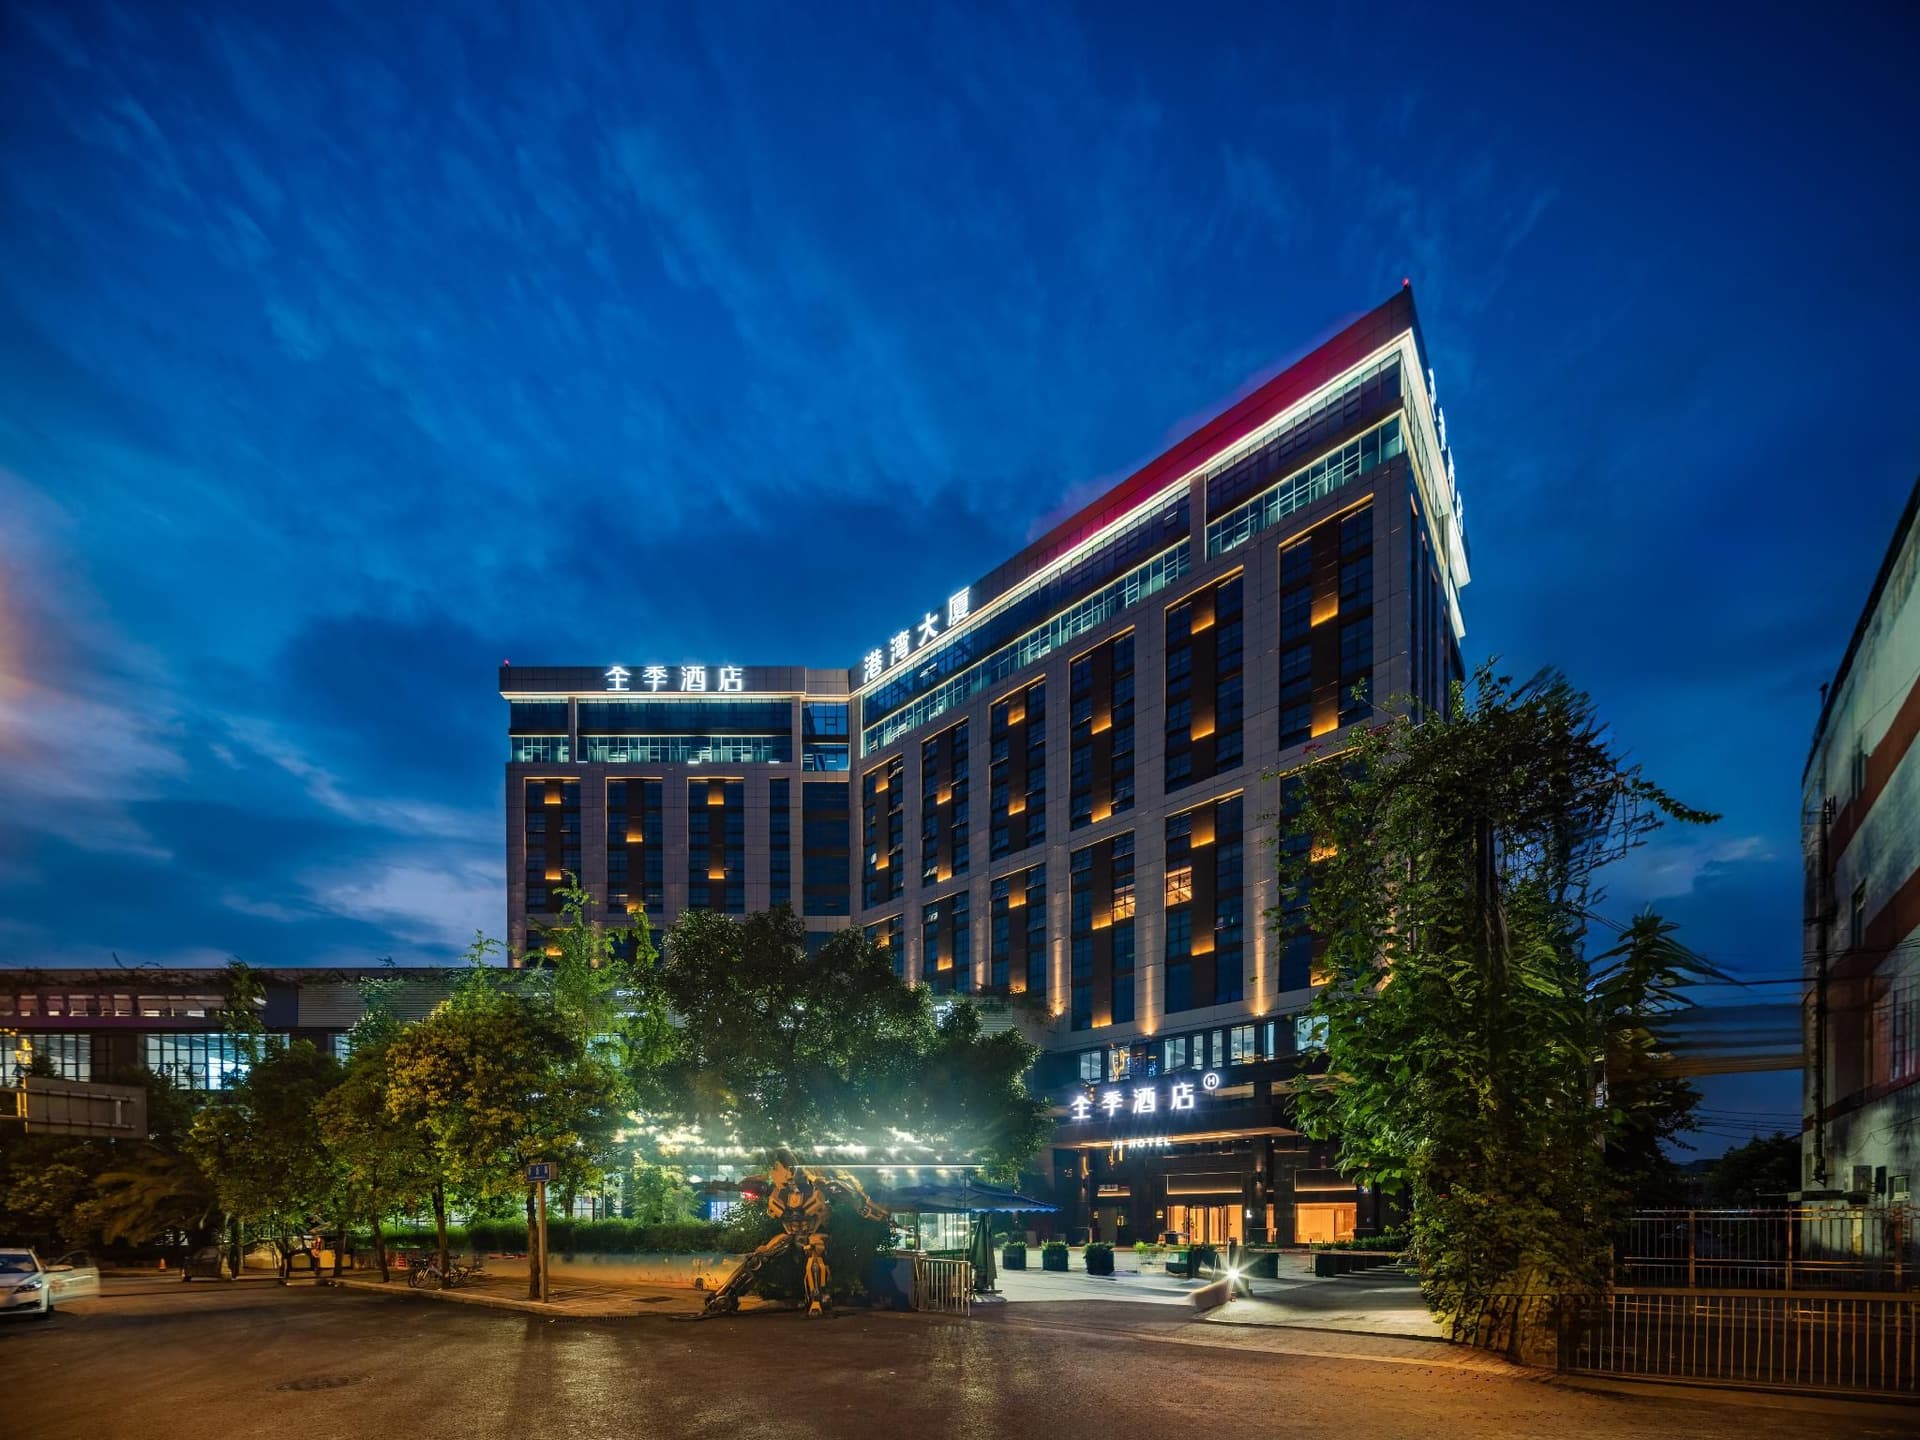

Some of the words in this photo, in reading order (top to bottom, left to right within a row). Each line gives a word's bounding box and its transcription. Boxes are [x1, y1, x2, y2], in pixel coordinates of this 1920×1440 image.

[864, 586, 970, 684] 港湾大厦
[605, 665, 743, 692] 全季酒店
[1071, 1083, 1195, 1119] 全季酒店
[1129, 1137, 1171, 1148] HOTEL
